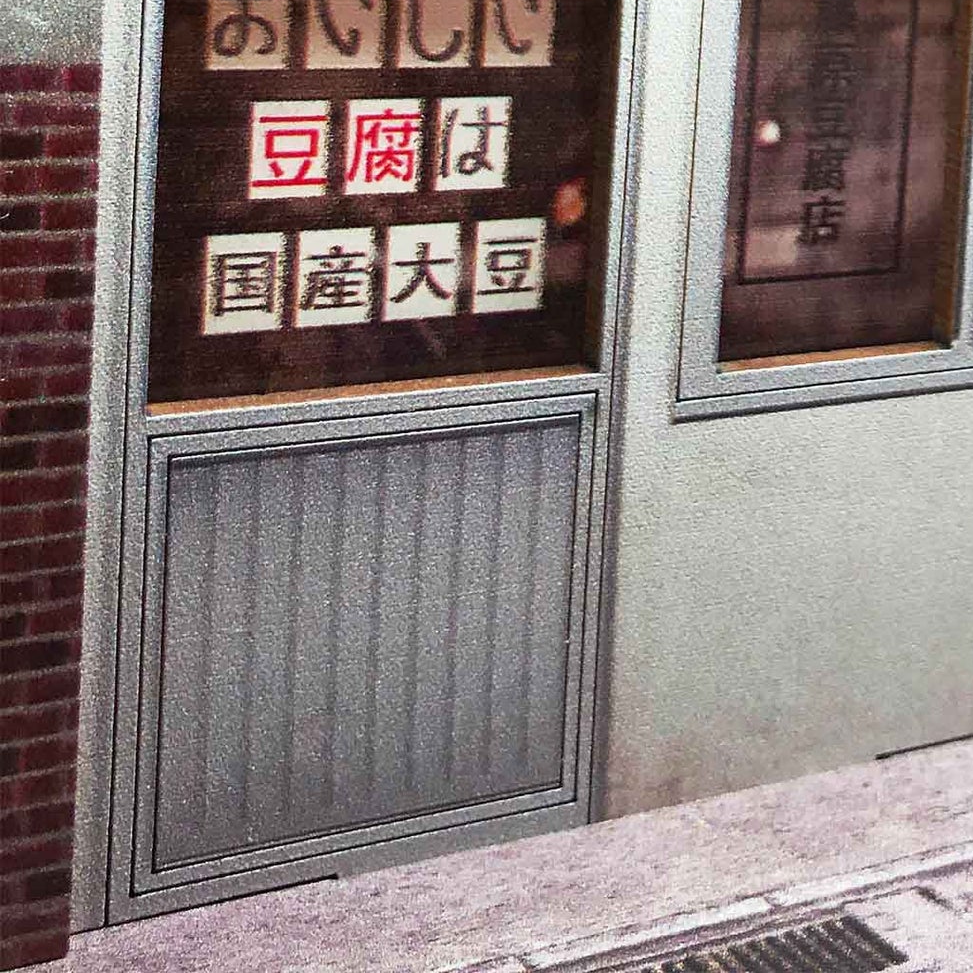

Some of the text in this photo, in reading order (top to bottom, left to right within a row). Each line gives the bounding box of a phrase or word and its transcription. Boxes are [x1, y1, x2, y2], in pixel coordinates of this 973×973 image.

[251, 106, 508, 188] 豆腐は
[213, 237, 542, 317] 国産大豆
